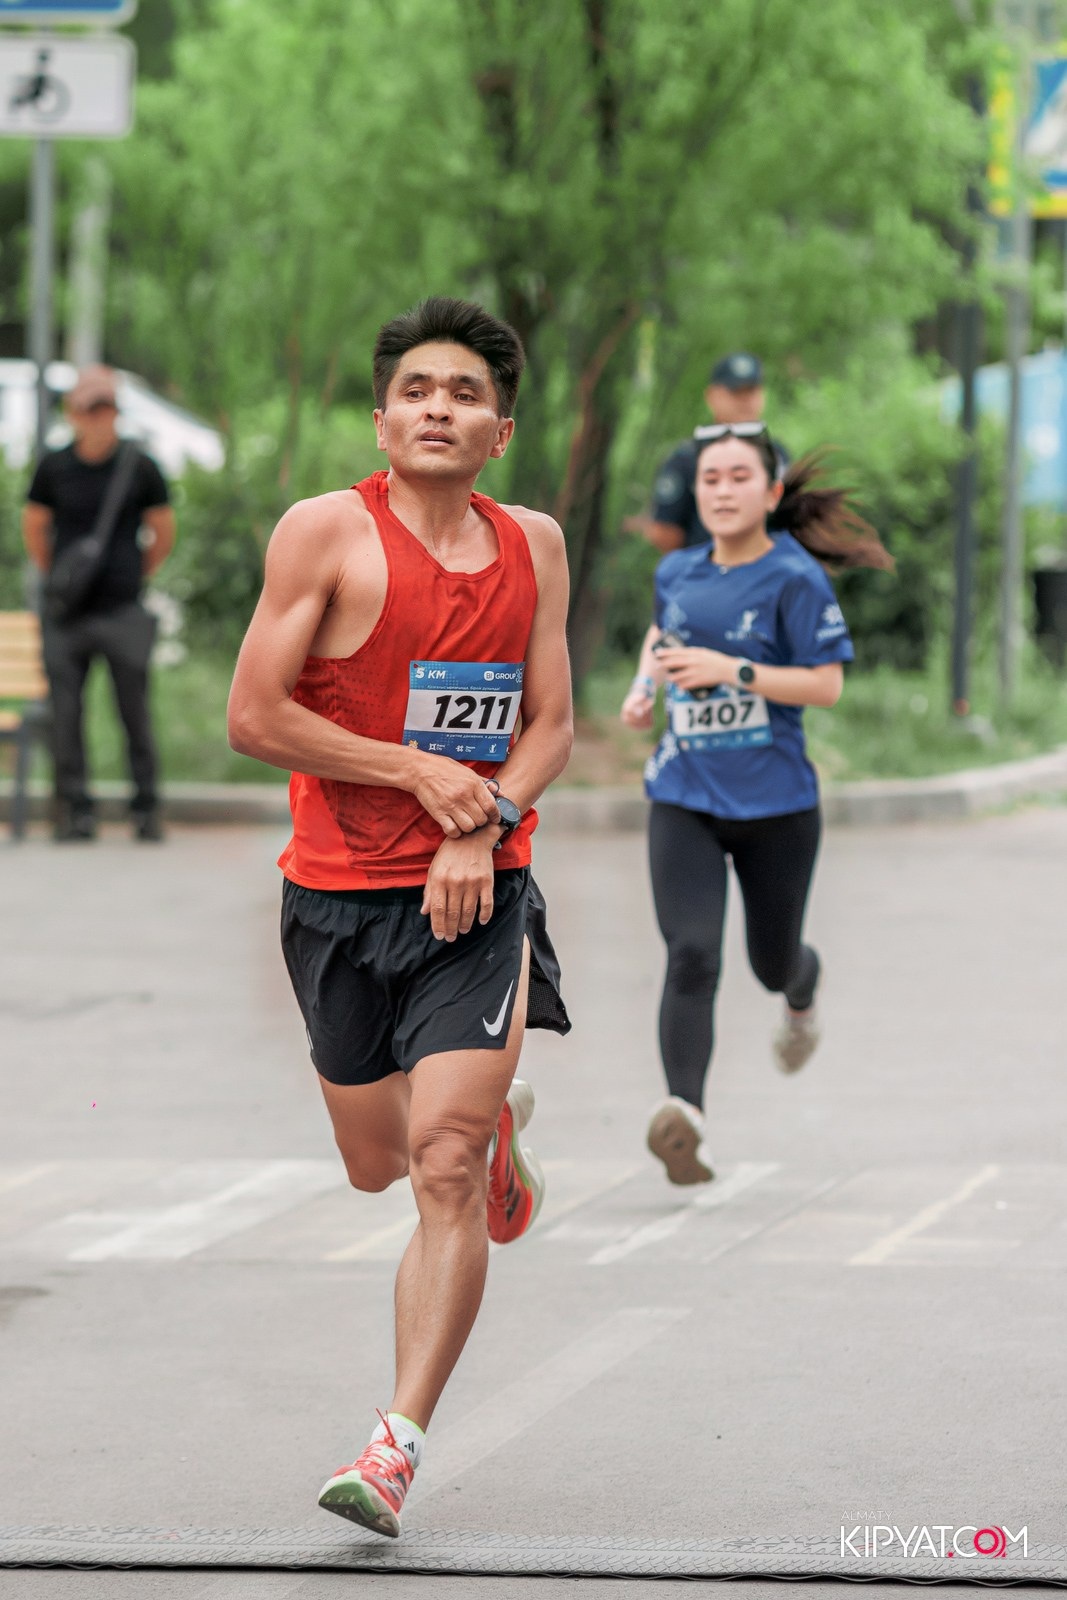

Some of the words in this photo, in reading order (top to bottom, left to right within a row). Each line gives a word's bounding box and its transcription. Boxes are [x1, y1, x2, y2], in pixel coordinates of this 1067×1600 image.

[415, 667, 425, 679] 5
[428, 670, 446, 679] KM
[433, 695, 512, 730] 1211
[688, 701, 754, 728] 1407
